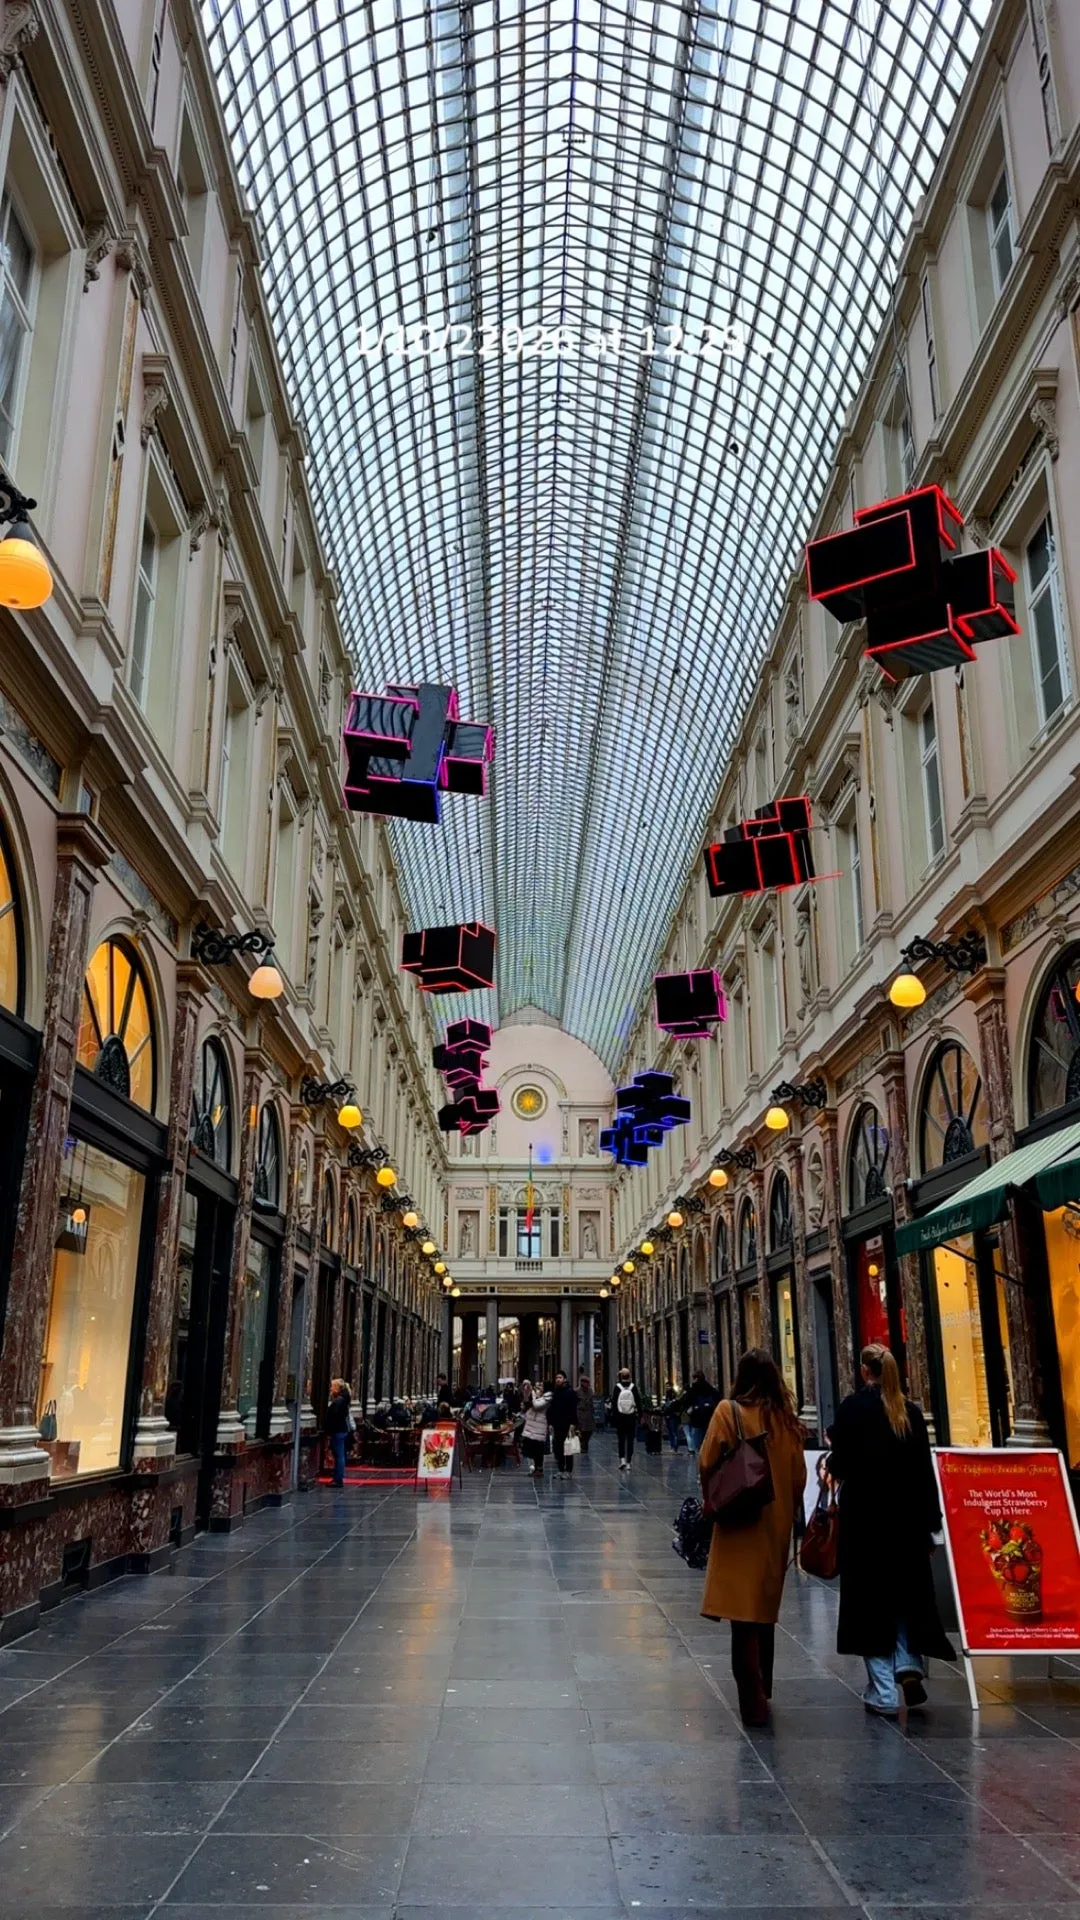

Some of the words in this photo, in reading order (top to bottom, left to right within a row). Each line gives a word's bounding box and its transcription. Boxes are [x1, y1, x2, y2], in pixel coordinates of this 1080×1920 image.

[968, 1489, 982, 1498] The
[984, 1489, 1015, 1498] World's
[1017, 1489, 1038, 1498] Most
[963, 1498, 1002, 1508] Indulgent
[1002, 1498, 1048, 1508] Strawberry
[984, 1506, 1001, 1516] Cup
[1002, 1507, 1010, 1516] Is
[1011, 1507, 1032, 1516] Here.
